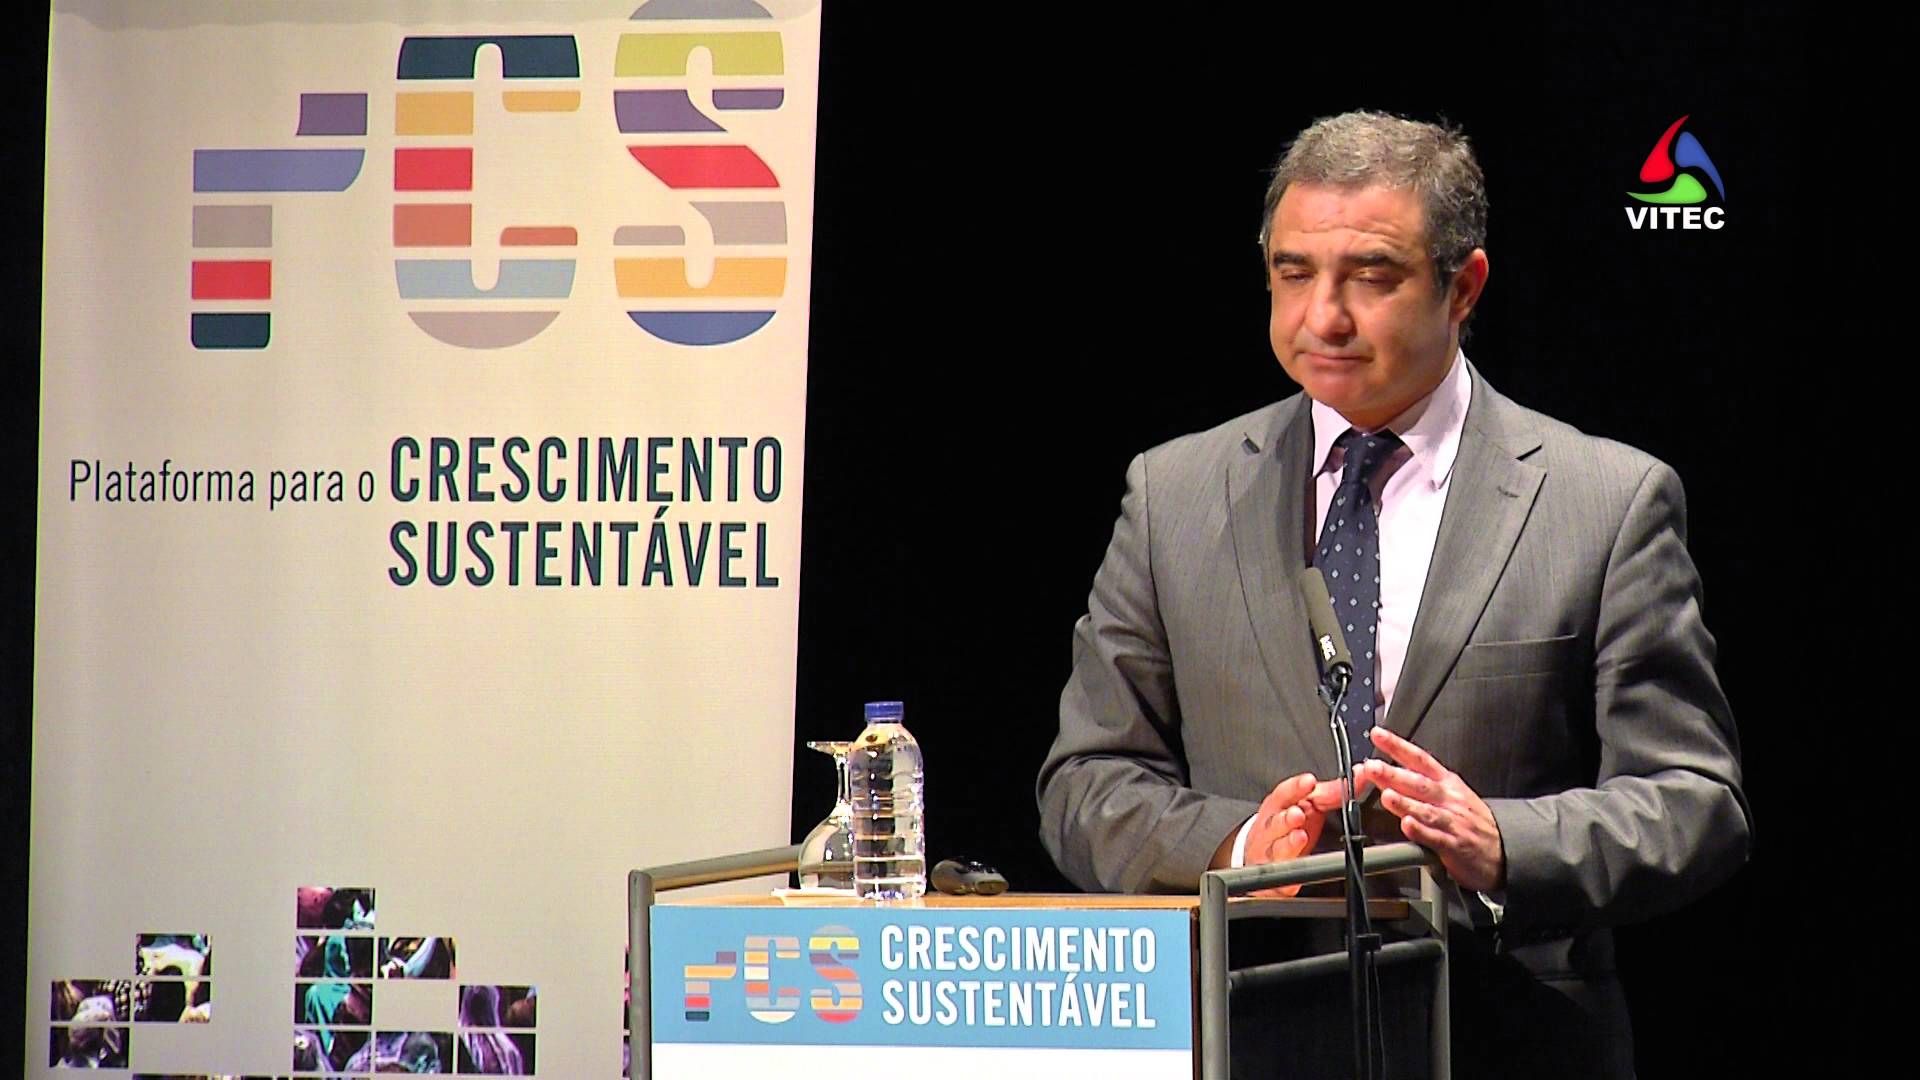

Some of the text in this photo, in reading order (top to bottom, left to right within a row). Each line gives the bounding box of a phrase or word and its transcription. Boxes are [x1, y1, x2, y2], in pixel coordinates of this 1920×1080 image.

[69, 436, 783, 511] Plataforma para o CRESCIMENTO
[387, 505, 780, 589] SUSTENTÁVEL
[880, 925, 1157, 973] CRESCIMENTO
[880, 973, 1156, 1029] SUSTENTÁVEL
